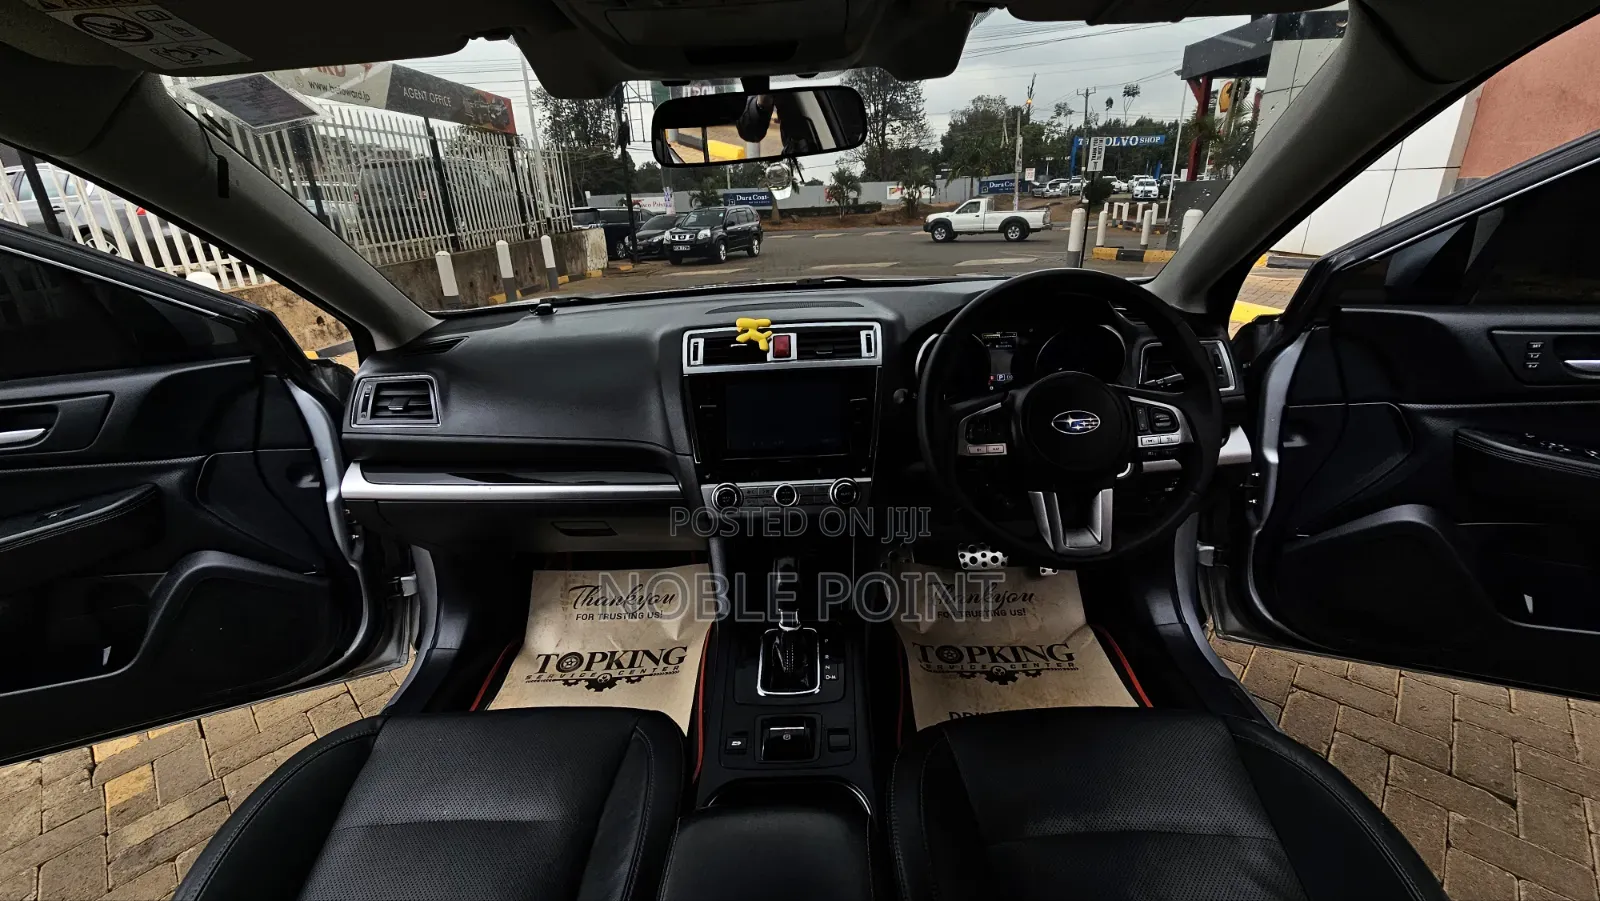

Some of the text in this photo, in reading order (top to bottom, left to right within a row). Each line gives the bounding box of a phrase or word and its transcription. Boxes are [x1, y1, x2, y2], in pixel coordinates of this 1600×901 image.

[403, 87, 452, 107] AGENT OFFICE
[1105, 136, 1139, 147] OLVO
[1140, 136, 1161, 144] SHOP
[568, 583, 676, 613] Thankyou
[576, 610, 663, 621] FOR TRUSTING US!
[1009, 608, 1027, 617] US!
[536, 645, 688, 674] TOPKING
[911, 642, 1076, 665] TOPKING
[524, 665, 680, 680] SERVICE CENTER
[1010, 662, 1076, 670] CENTER
